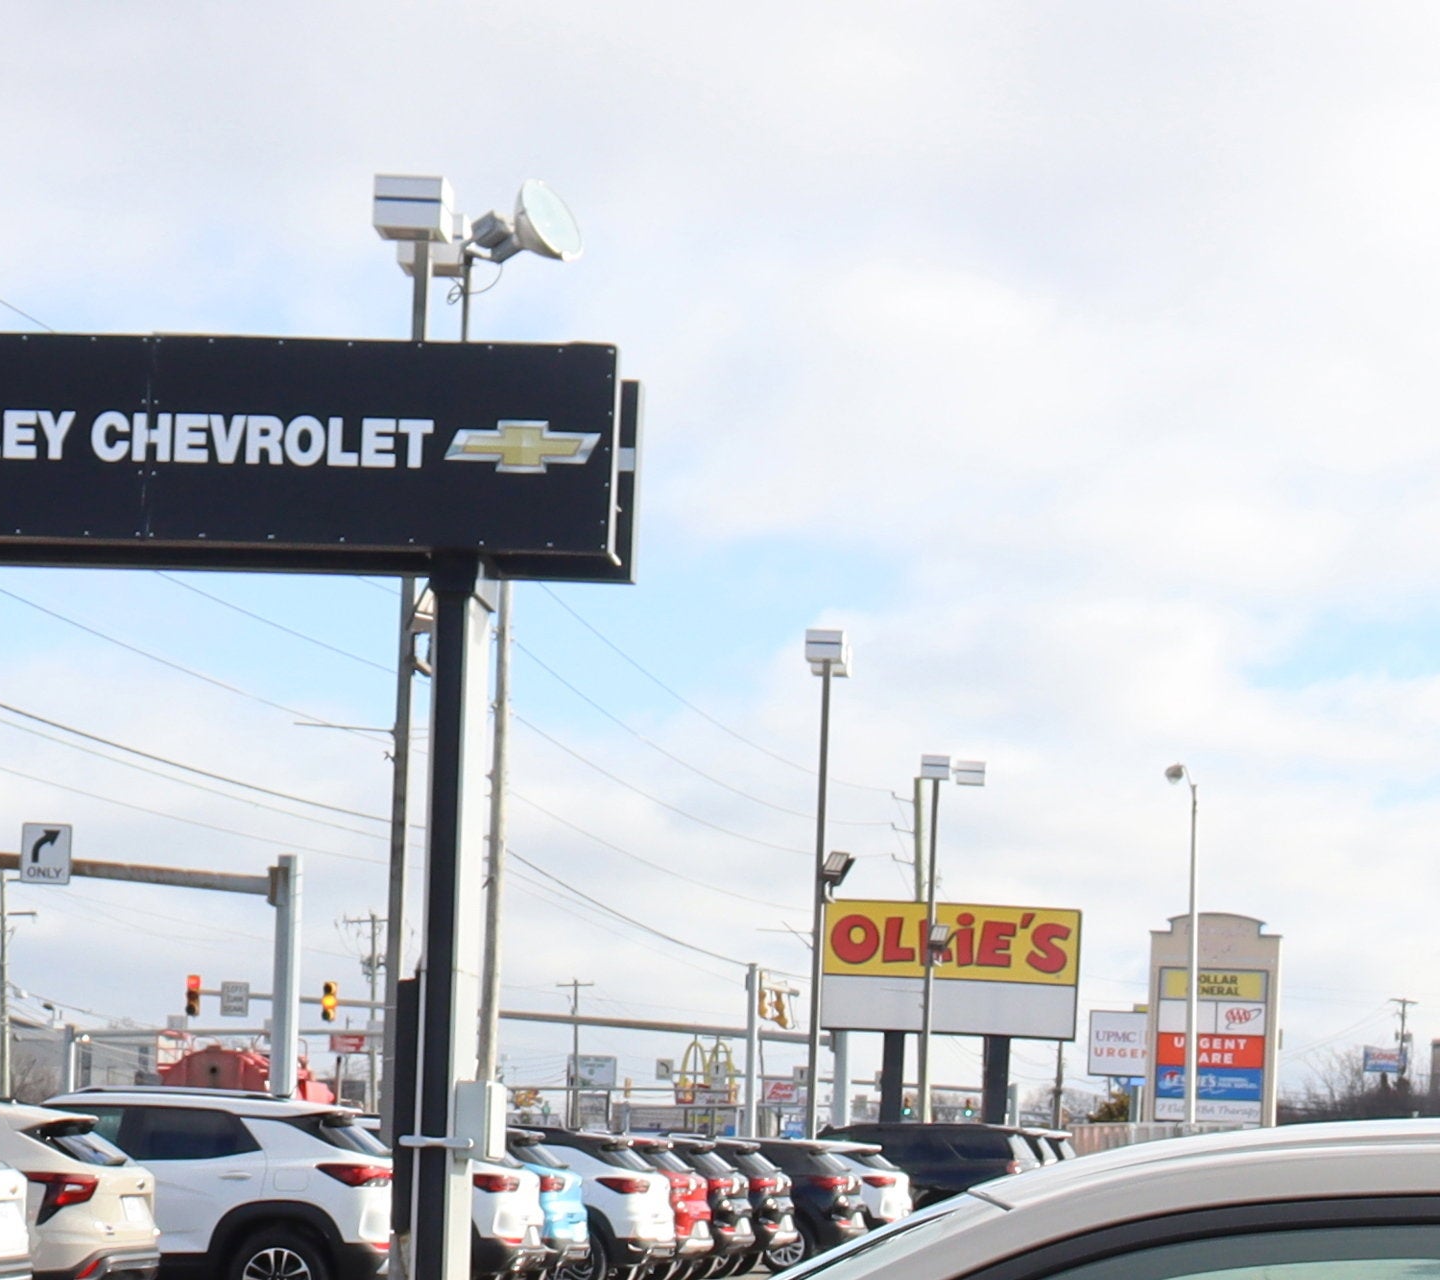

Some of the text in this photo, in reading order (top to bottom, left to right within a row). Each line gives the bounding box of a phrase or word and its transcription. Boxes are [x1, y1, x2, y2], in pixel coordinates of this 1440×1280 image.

[90, 410, 435, 468] CHEVROLET
[26, 866, 63, 879] ONLY
[1198, 974, 1239, 985] OLLAR
[1198, 985, 1240, 997] NERAL
[1095, 1030, 1137, 1042] UPMC
[1173, 1036, 1248, 1050] UGENT
[1198, 1052, 1234, 1064] ARE
